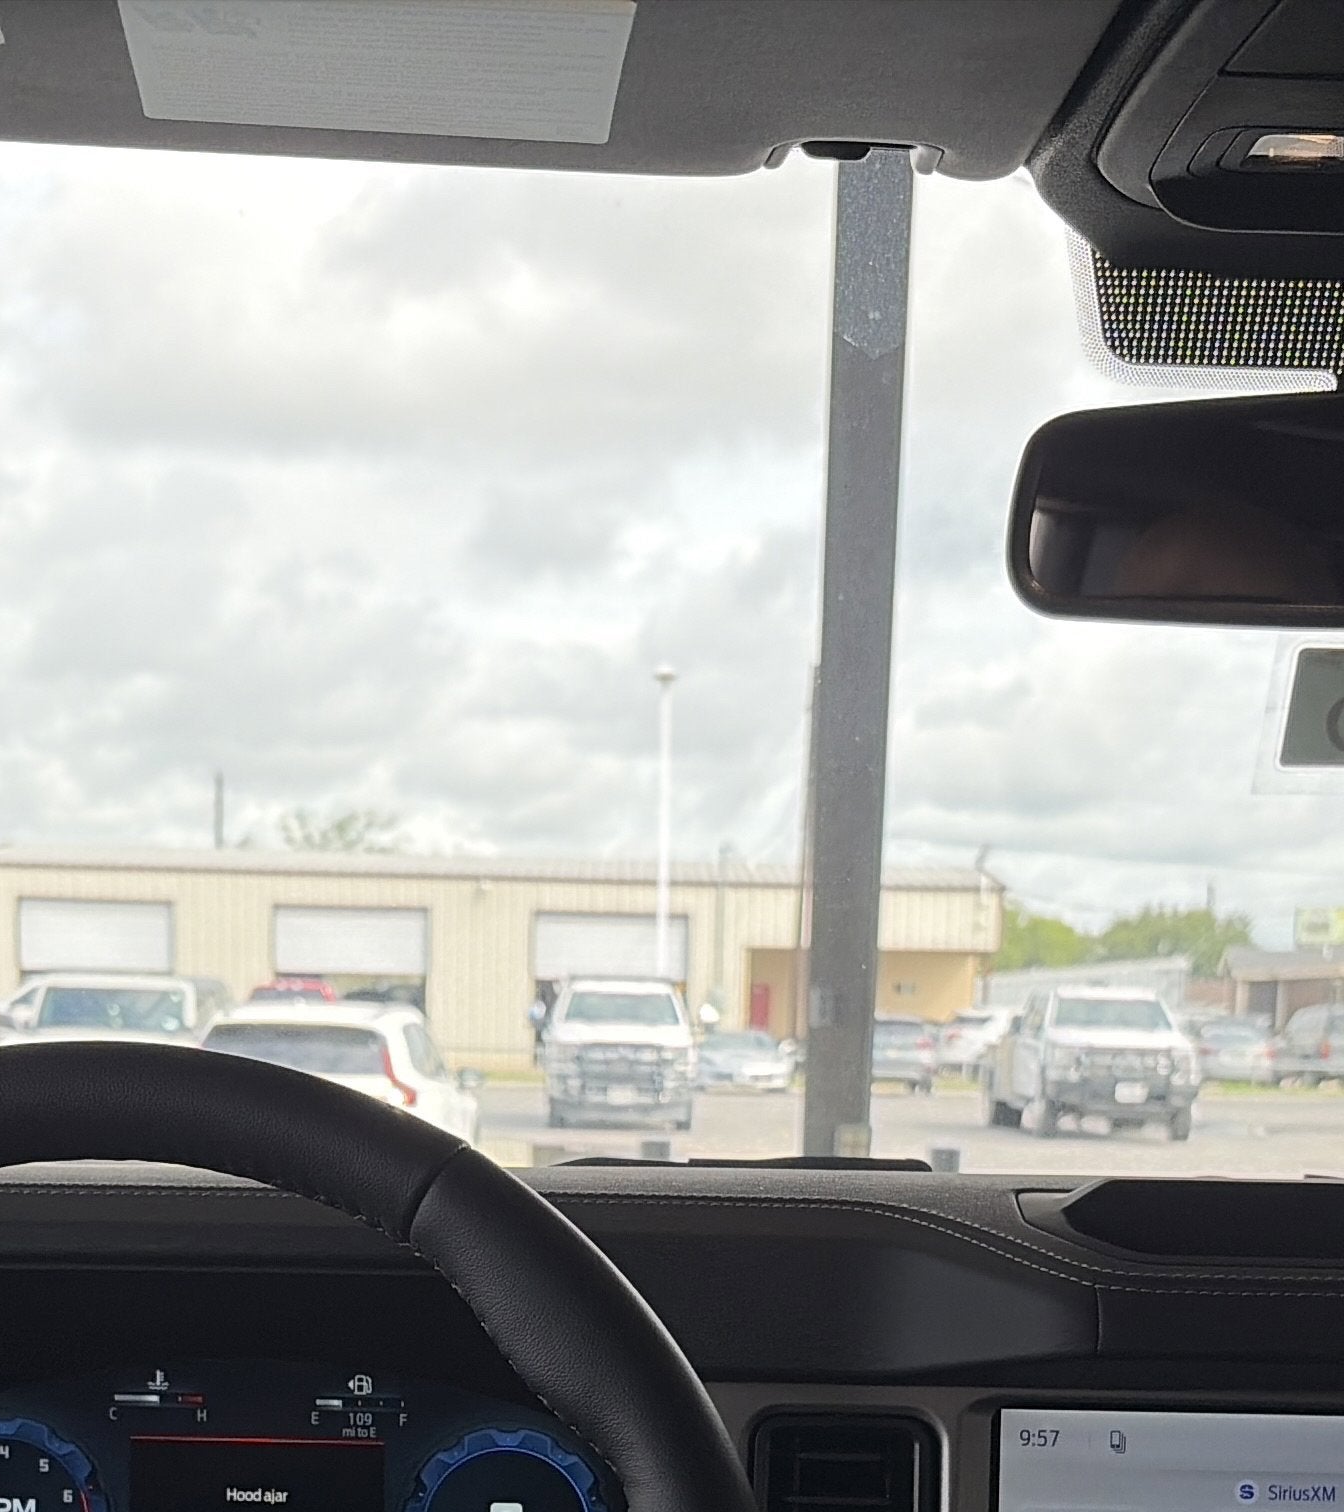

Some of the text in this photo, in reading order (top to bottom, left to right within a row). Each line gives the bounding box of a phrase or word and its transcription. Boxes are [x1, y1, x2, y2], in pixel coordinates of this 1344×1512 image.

[197, 1410, 207, 1422] H
[311, 1411, 319, 1424] E
[348, 1412, 373, 1427] 109
[399, 1413, 407, 1427] F
[342, 1427, 377, 1438] mi to E
[1019, 1430, 1060, 1447] 9:57
[38, 1458, 49, 1472] 5
[63, 1489, 73, 1503] 6
[226, 1488, 288, 1504] Hood ajar
[1268, 1486, 1336, 1502] SiriusXM
